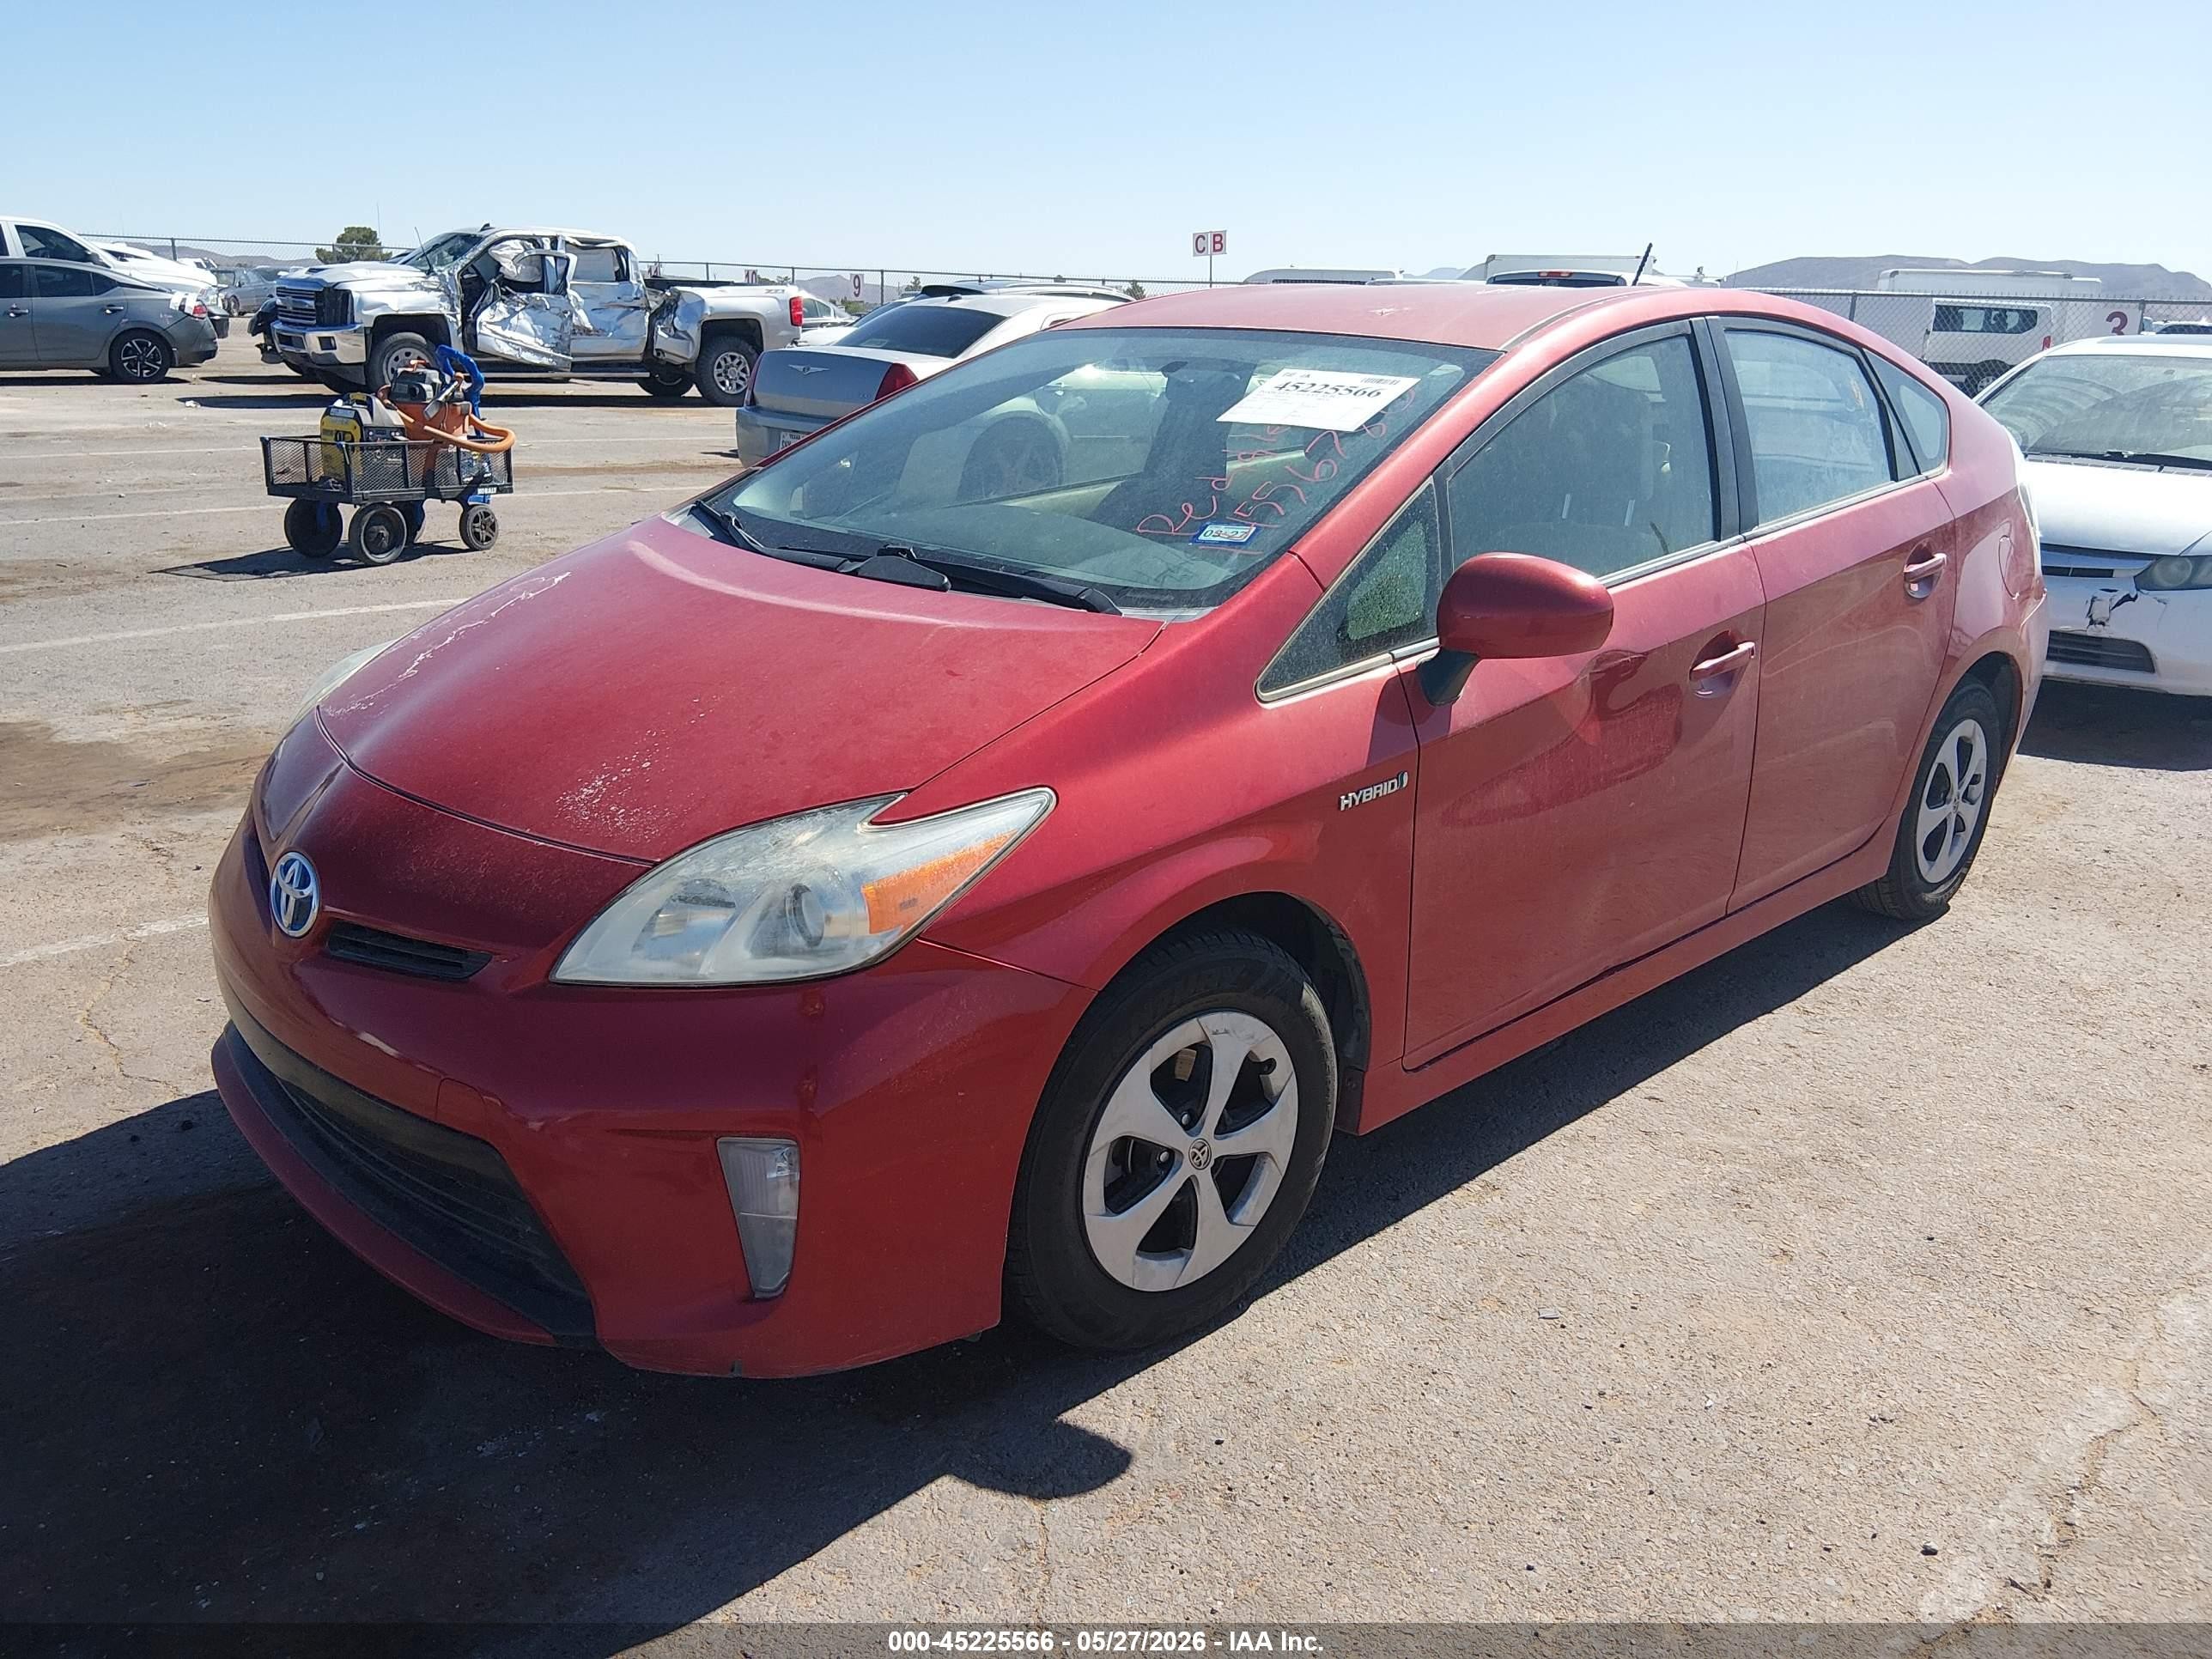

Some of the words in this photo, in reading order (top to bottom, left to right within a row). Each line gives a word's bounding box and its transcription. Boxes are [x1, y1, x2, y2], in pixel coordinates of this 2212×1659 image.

[1194, 234, 1206, 254] C
[1212, 233, 1224, 253] B
[853, 274, 861, 298] 9
[1273, 380, 1386, 398] 45225566
[1340, 778, 1398, 811] HYBRID
